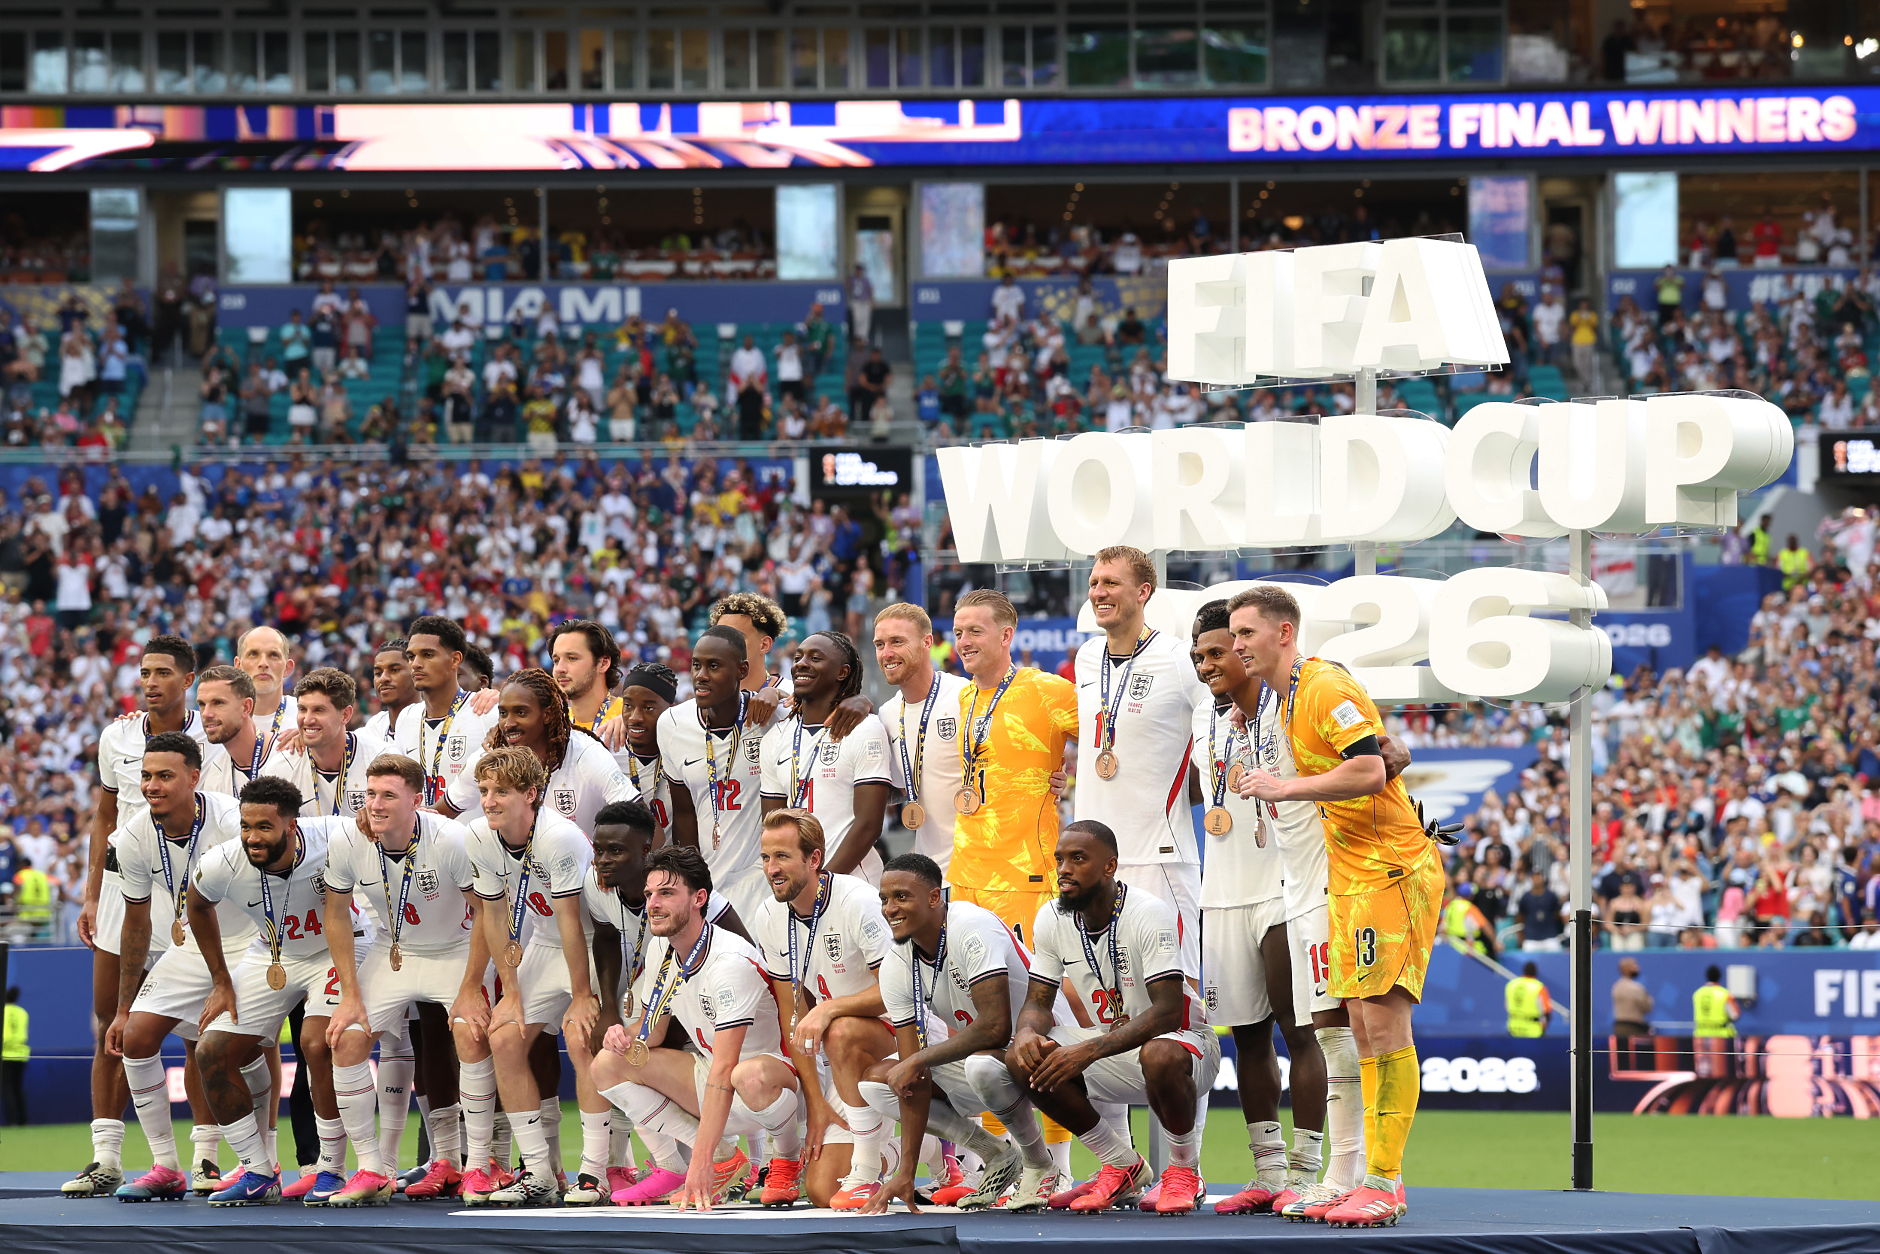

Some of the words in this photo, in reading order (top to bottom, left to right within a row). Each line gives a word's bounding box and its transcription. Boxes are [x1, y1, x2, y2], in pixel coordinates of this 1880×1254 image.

[1228, 106, 1441, 152] BRONZE
[1449, 102, 1605, 148] FINAL
[1608, 96, 1857, 144] WINNERS
[430, 287, 641, 322] MIAMI
[1167, 238, 1455, 385] FIFA
[936, 415, 1410, 564] WORLD
[1444, 394, 1734, 533] CUP
[1594, 623, 1672, 647] 026
[925, 693, 934, 710] WORLD
[994, 687, 1004, 698] FIFA
[1258, 686, 1268, 705] 2026
[902, 756, 910, 774] WORLD
[977, 769, 987, 805] 1
[162, 856, 170, 875] WORLD
[285, 909, 322, 940] 24
[404, 902, 421, 926] 8
[694, 939, 703, 950] CUP
[1081, 930, 1089, 949] WORLD
[1355, 926, 1377, 968] 13
[684, 949, 698, 966] 2026
[648, 992, 659, 1010] 2026
[1421, 1057, 1538, 1093] 2026
[385, 1086, 404, 1094] ENG
